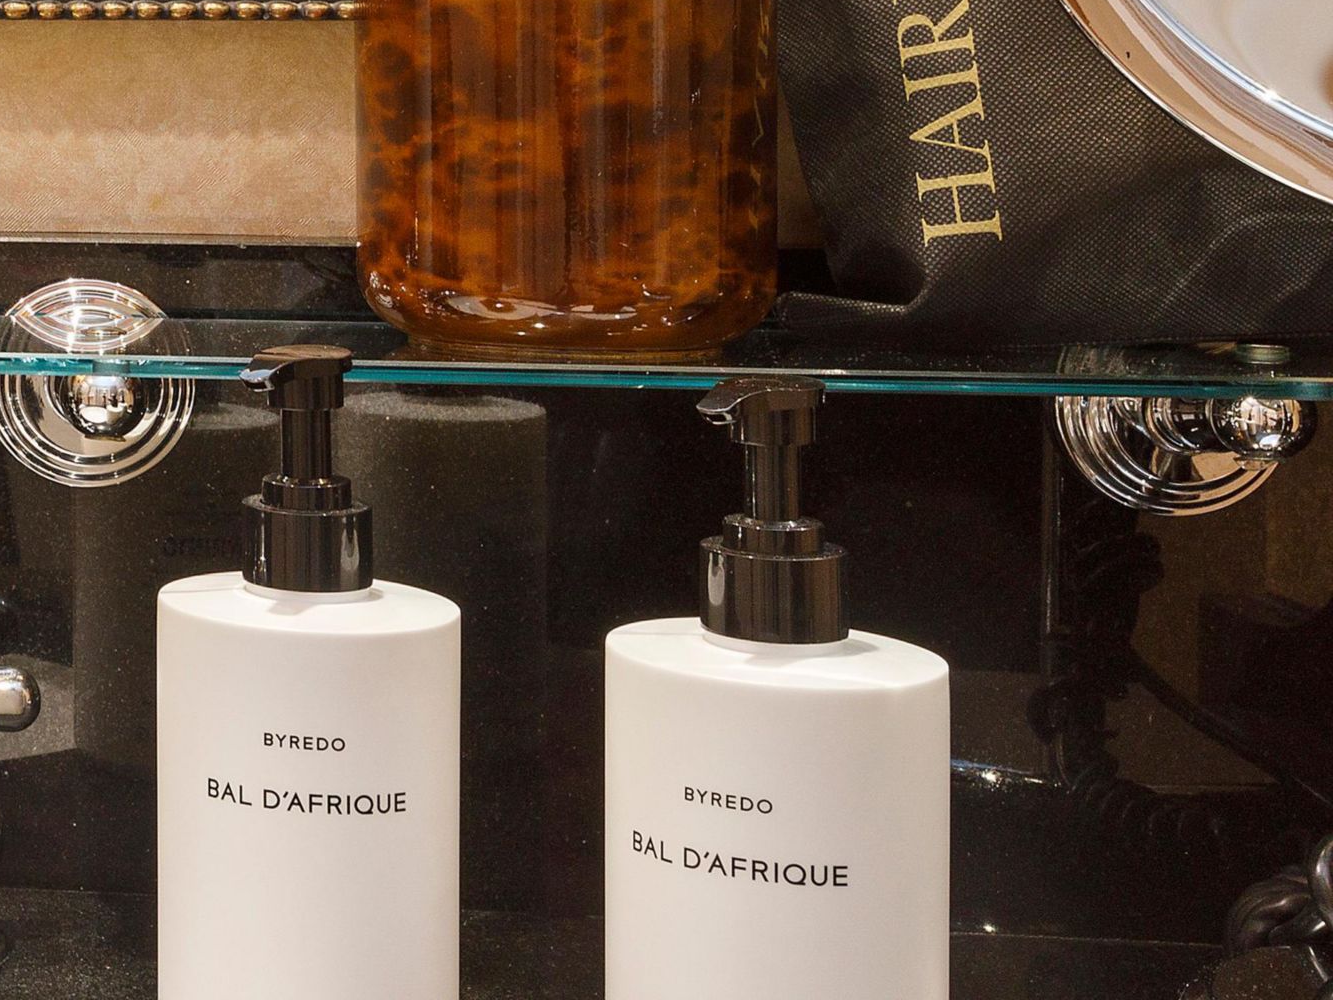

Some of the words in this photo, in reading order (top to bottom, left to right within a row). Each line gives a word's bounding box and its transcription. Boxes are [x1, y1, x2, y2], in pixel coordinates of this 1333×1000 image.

[263, 731, 346, 753] BYREDO
[207, 777, 253, 807] BAL
[262, 789, 407, 816] D'AFRIQUE
[684, 785, 774, 815] BYREDO
[632, 829, 674, 865] BAL
[683, 846, 849, 888] D'AFRIQUE
